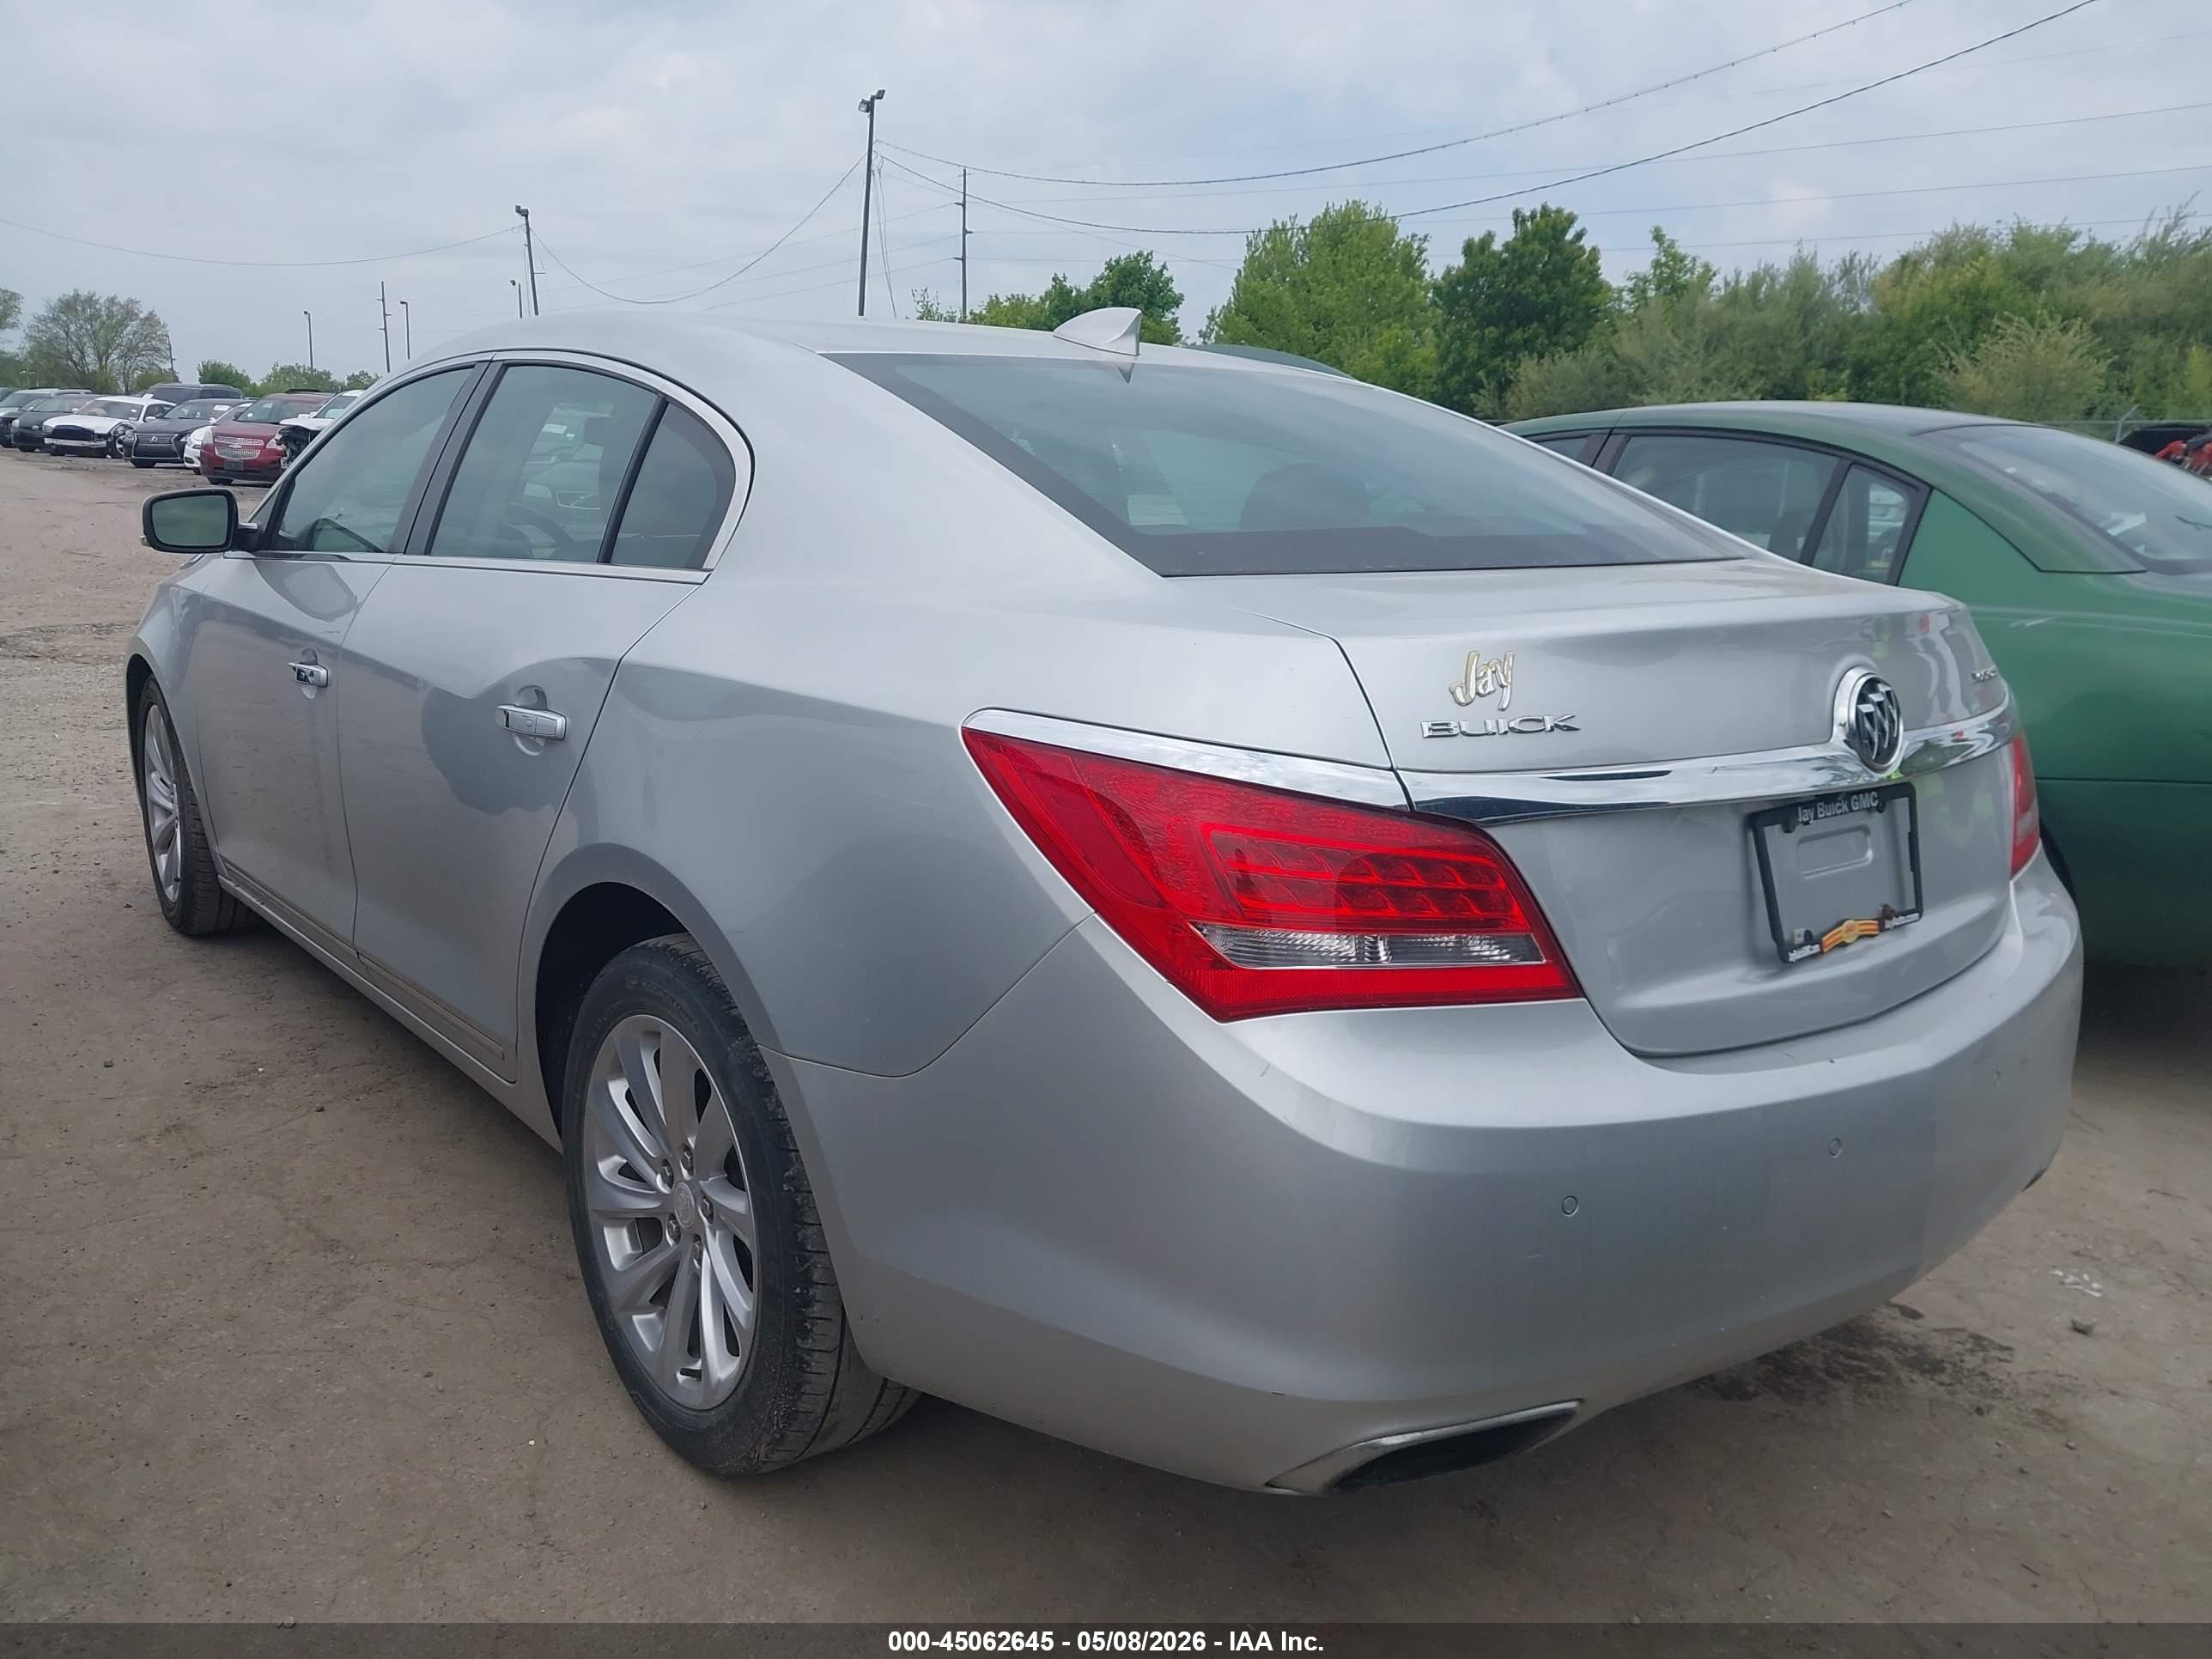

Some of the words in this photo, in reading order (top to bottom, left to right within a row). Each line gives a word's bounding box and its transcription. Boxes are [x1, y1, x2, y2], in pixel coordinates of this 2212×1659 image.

[1449, 650, 1515, 712] Jay
[1421, 714, 1581, 738] BUICK
[1798, 806, 1814, 824] Jay
[1816, 799, 1849, 818] Buick
[1851, 791, 1879, 811] GMC
